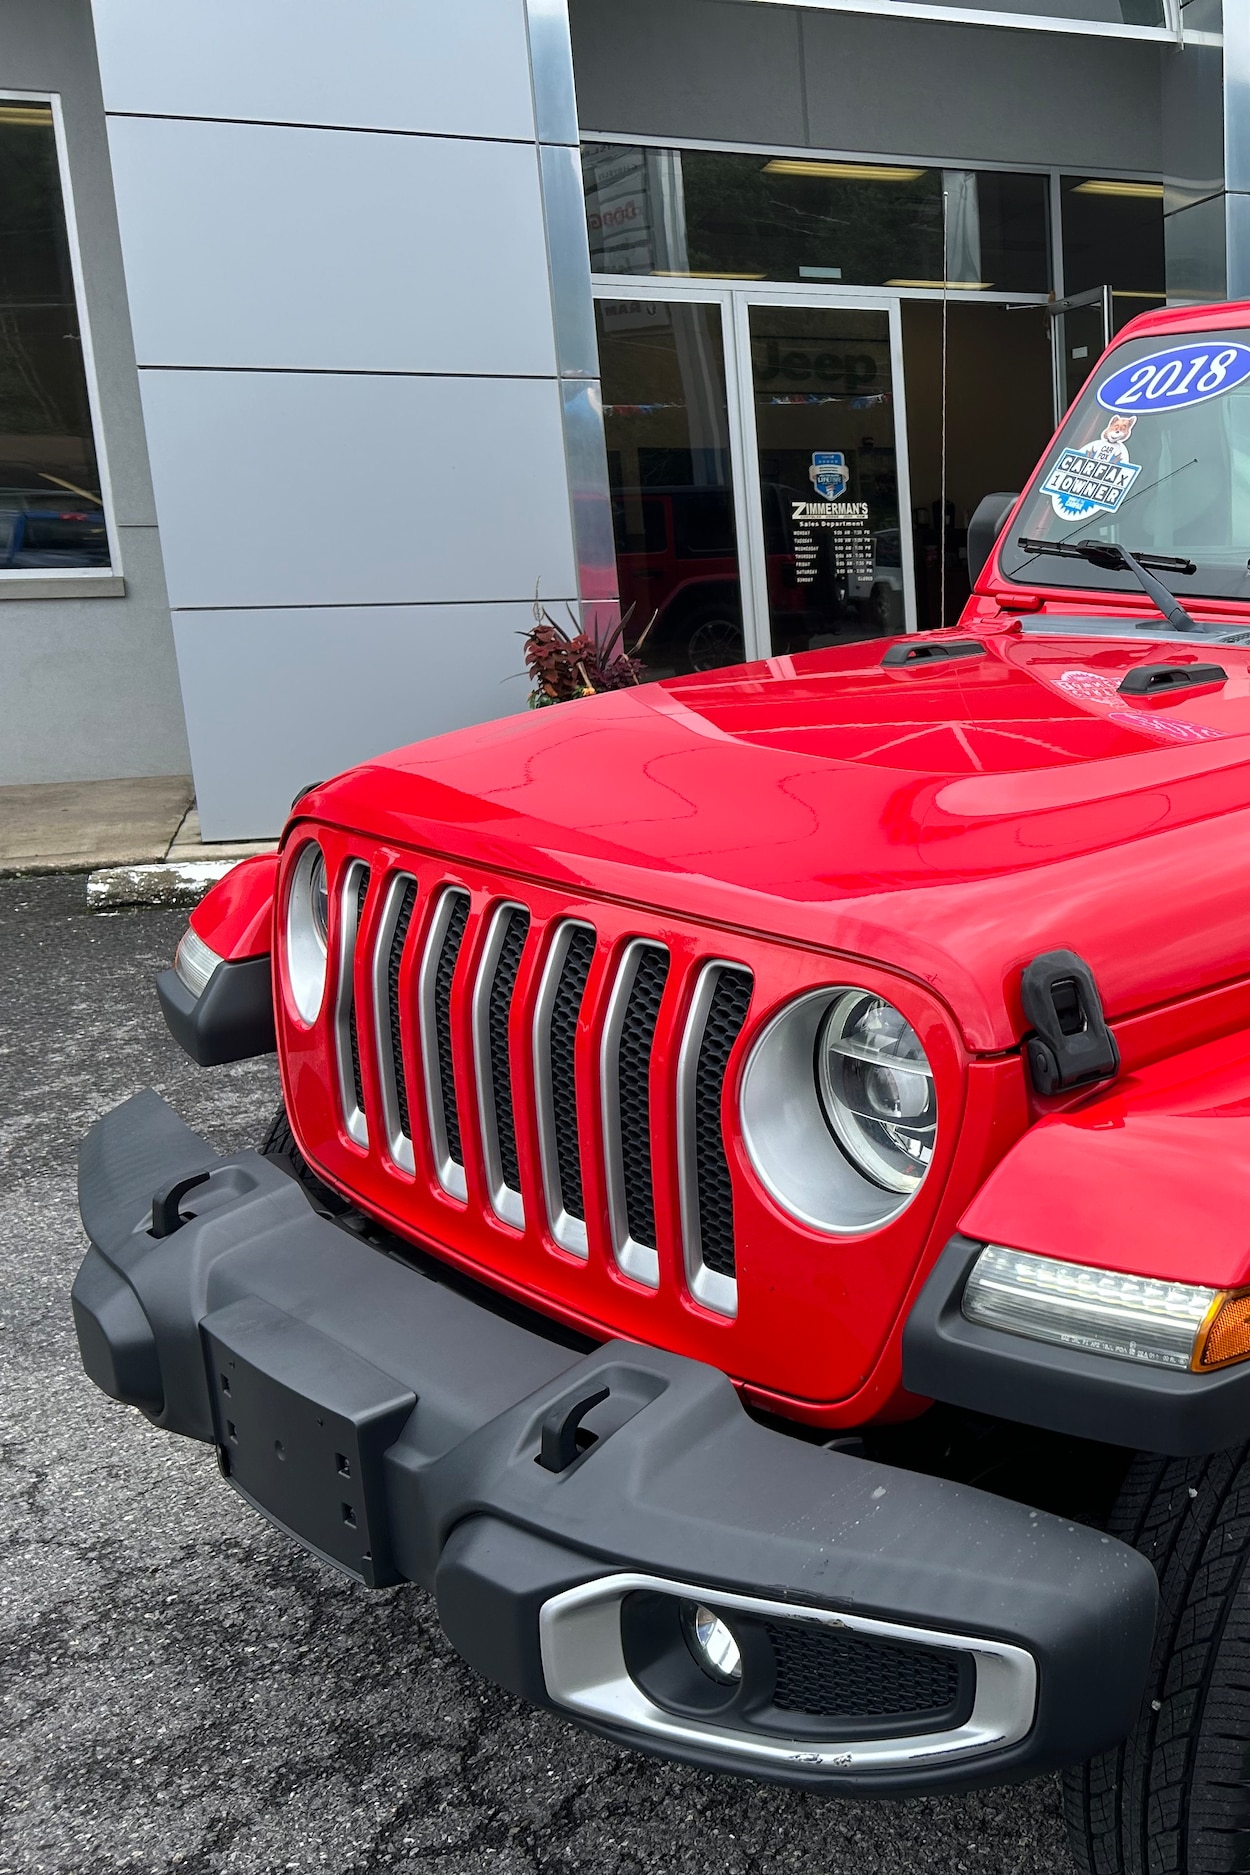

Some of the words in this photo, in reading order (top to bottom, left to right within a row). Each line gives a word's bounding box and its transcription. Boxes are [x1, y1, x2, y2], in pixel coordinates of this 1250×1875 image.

[757, 340, 877, 390] Jeep
[1114, 348, 1238, 406] 2018
[1096, 452, 1110, 461] FOX
[1100, 445, 1114, 454] CAR
[1060, 454, 1131, 487] CARFAX
[791, 501, 869, 519] ZIMMERMAN'S
[821, 520, 864, 528] Department
